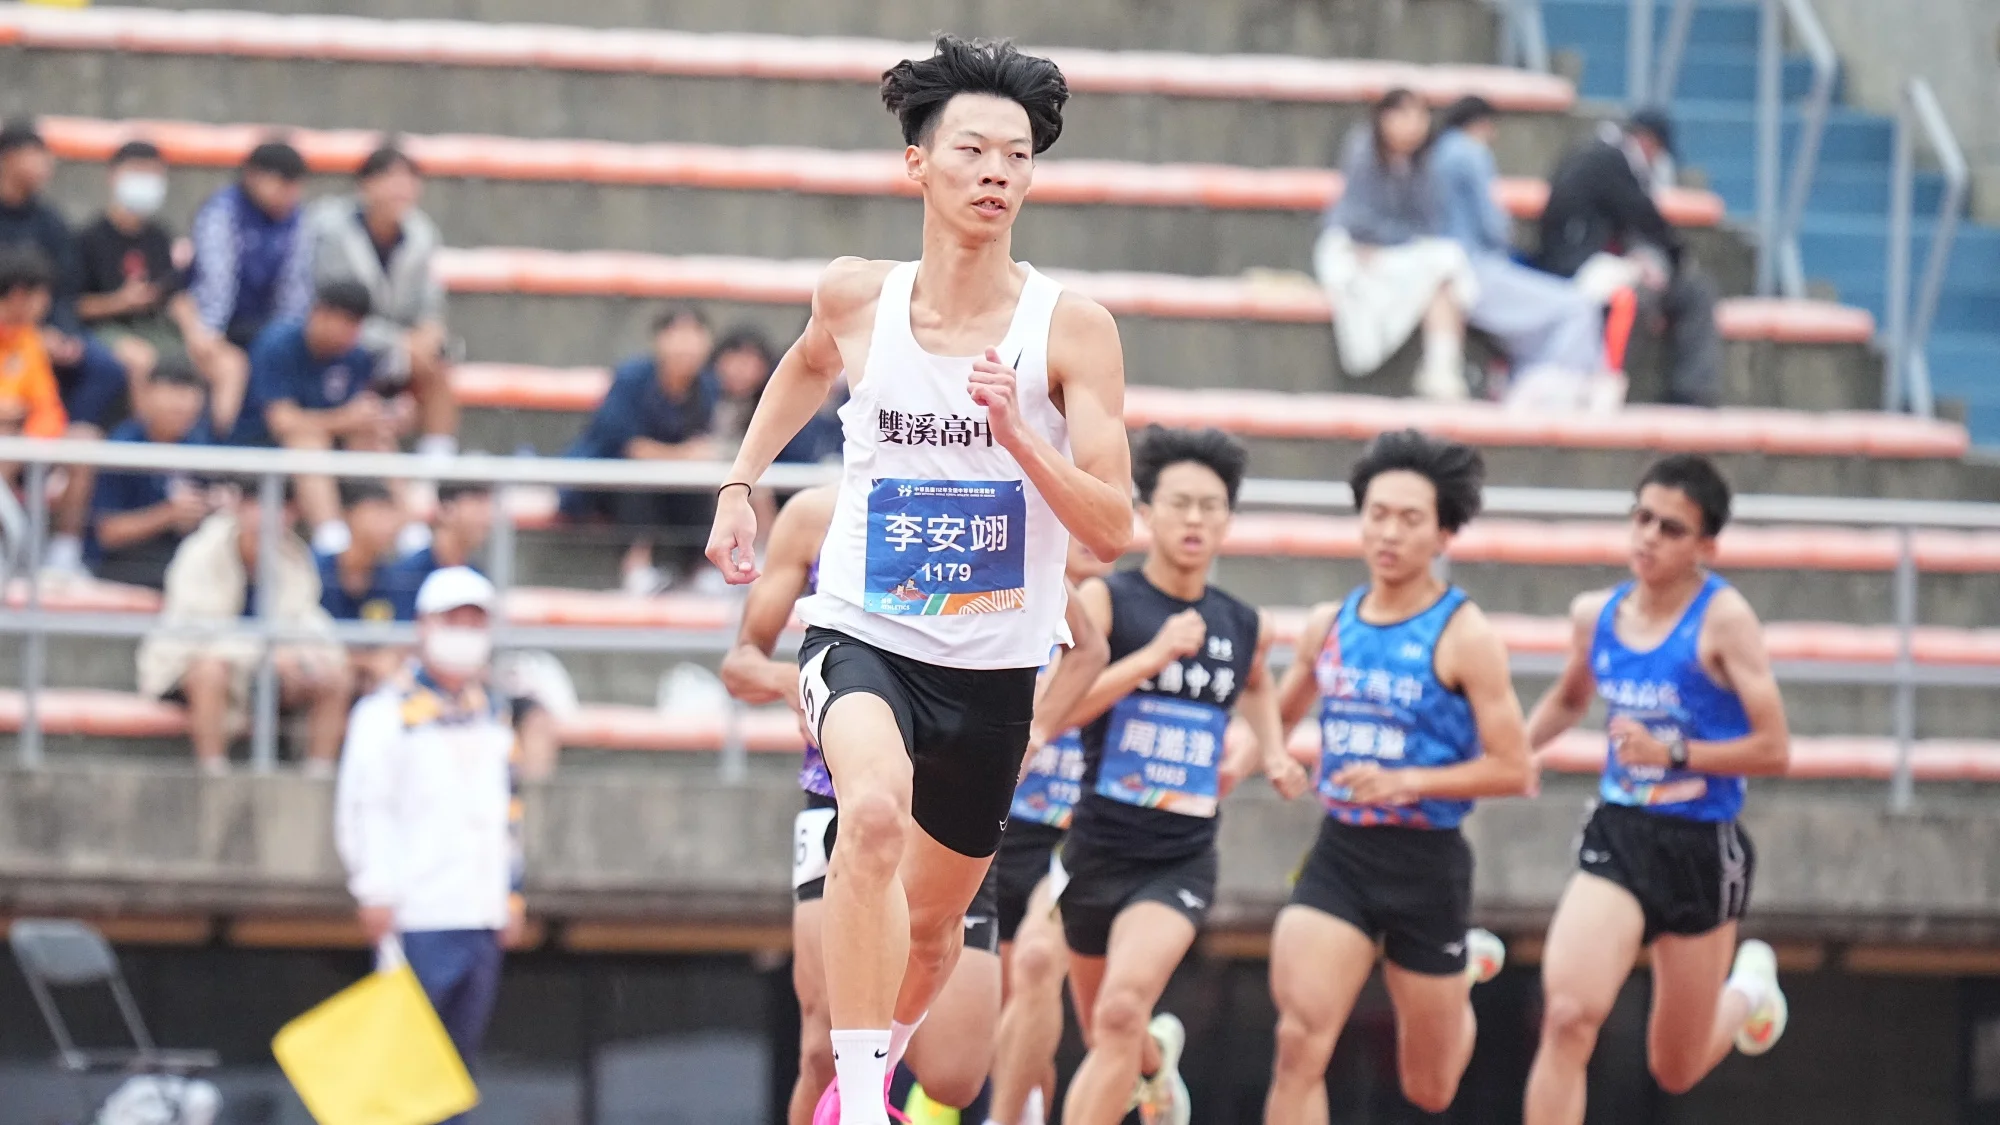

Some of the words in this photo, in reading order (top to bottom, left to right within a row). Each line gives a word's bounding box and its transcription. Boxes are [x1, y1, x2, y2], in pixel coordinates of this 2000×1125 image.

[878, 409, 992, 447] 雙溪高中
[885, 513, 1008, 552] 李安翊
[921, 563, 972, 582] 1179
[1137, 661, 1236, 703] 國中學
